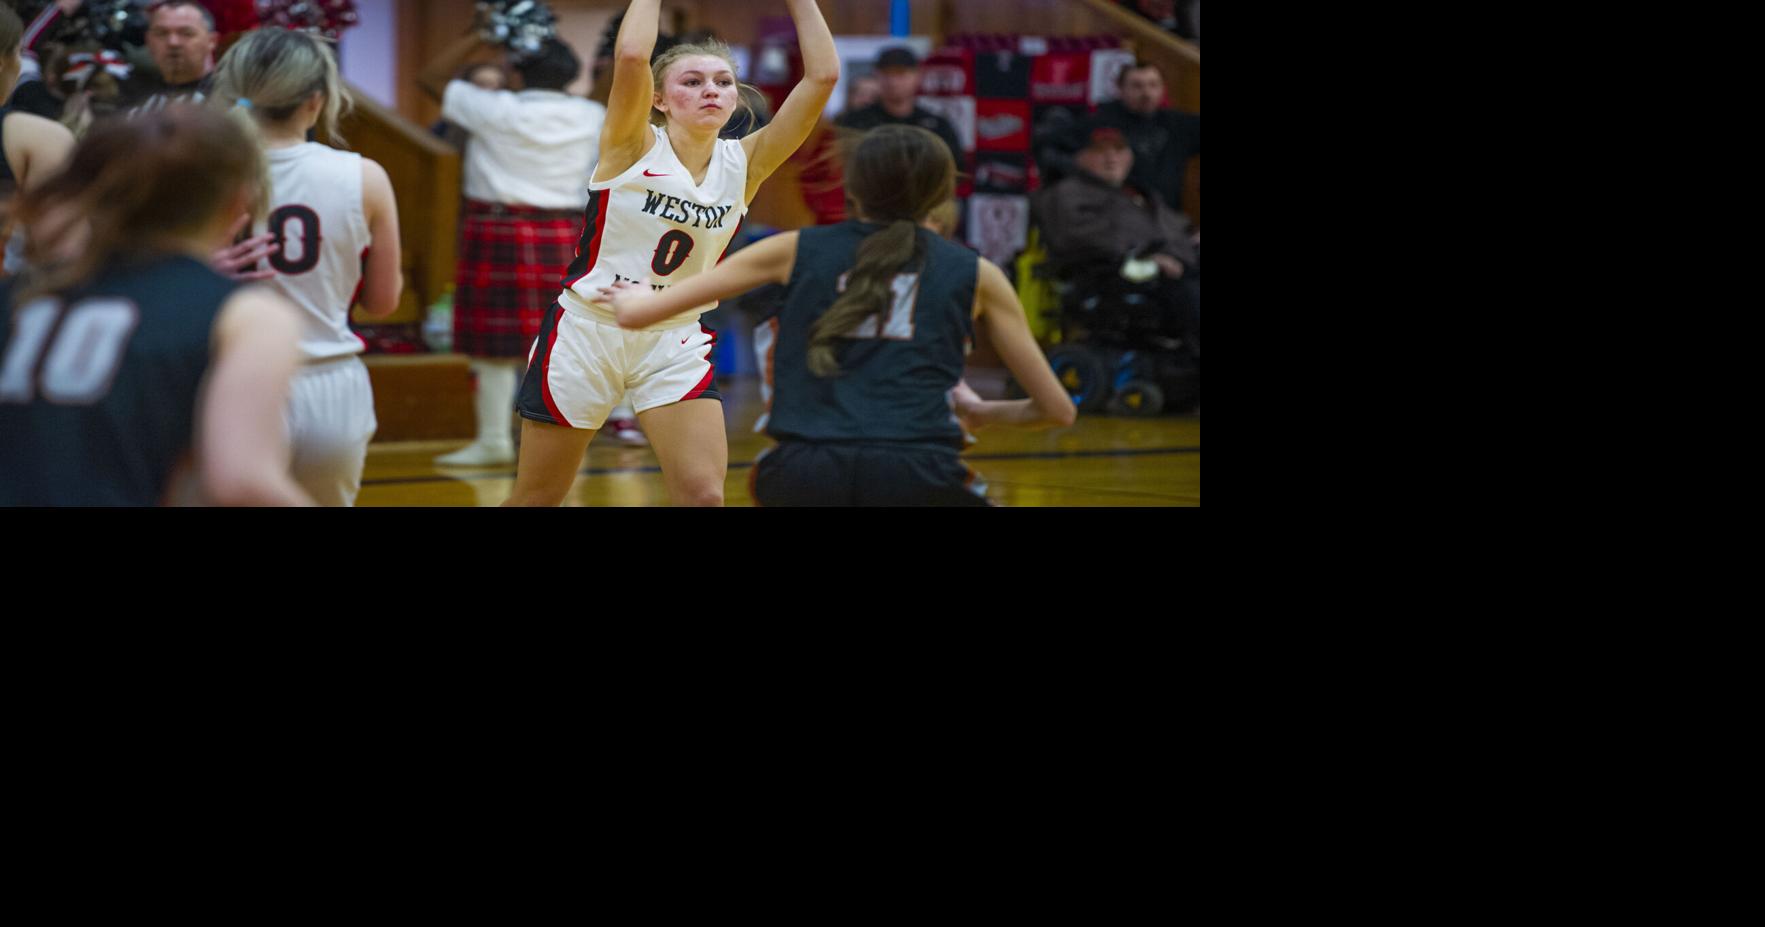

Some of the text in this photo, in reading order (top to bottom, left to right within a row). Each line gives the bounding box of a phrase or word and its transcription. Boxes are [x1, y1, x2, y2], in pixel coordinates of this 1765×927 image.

[641, 189, 732, 229] WESTON
[233, 204, 322, 275] 0
[651, 229, 694, 276] 0
[0, 298, 139, 403] 10
